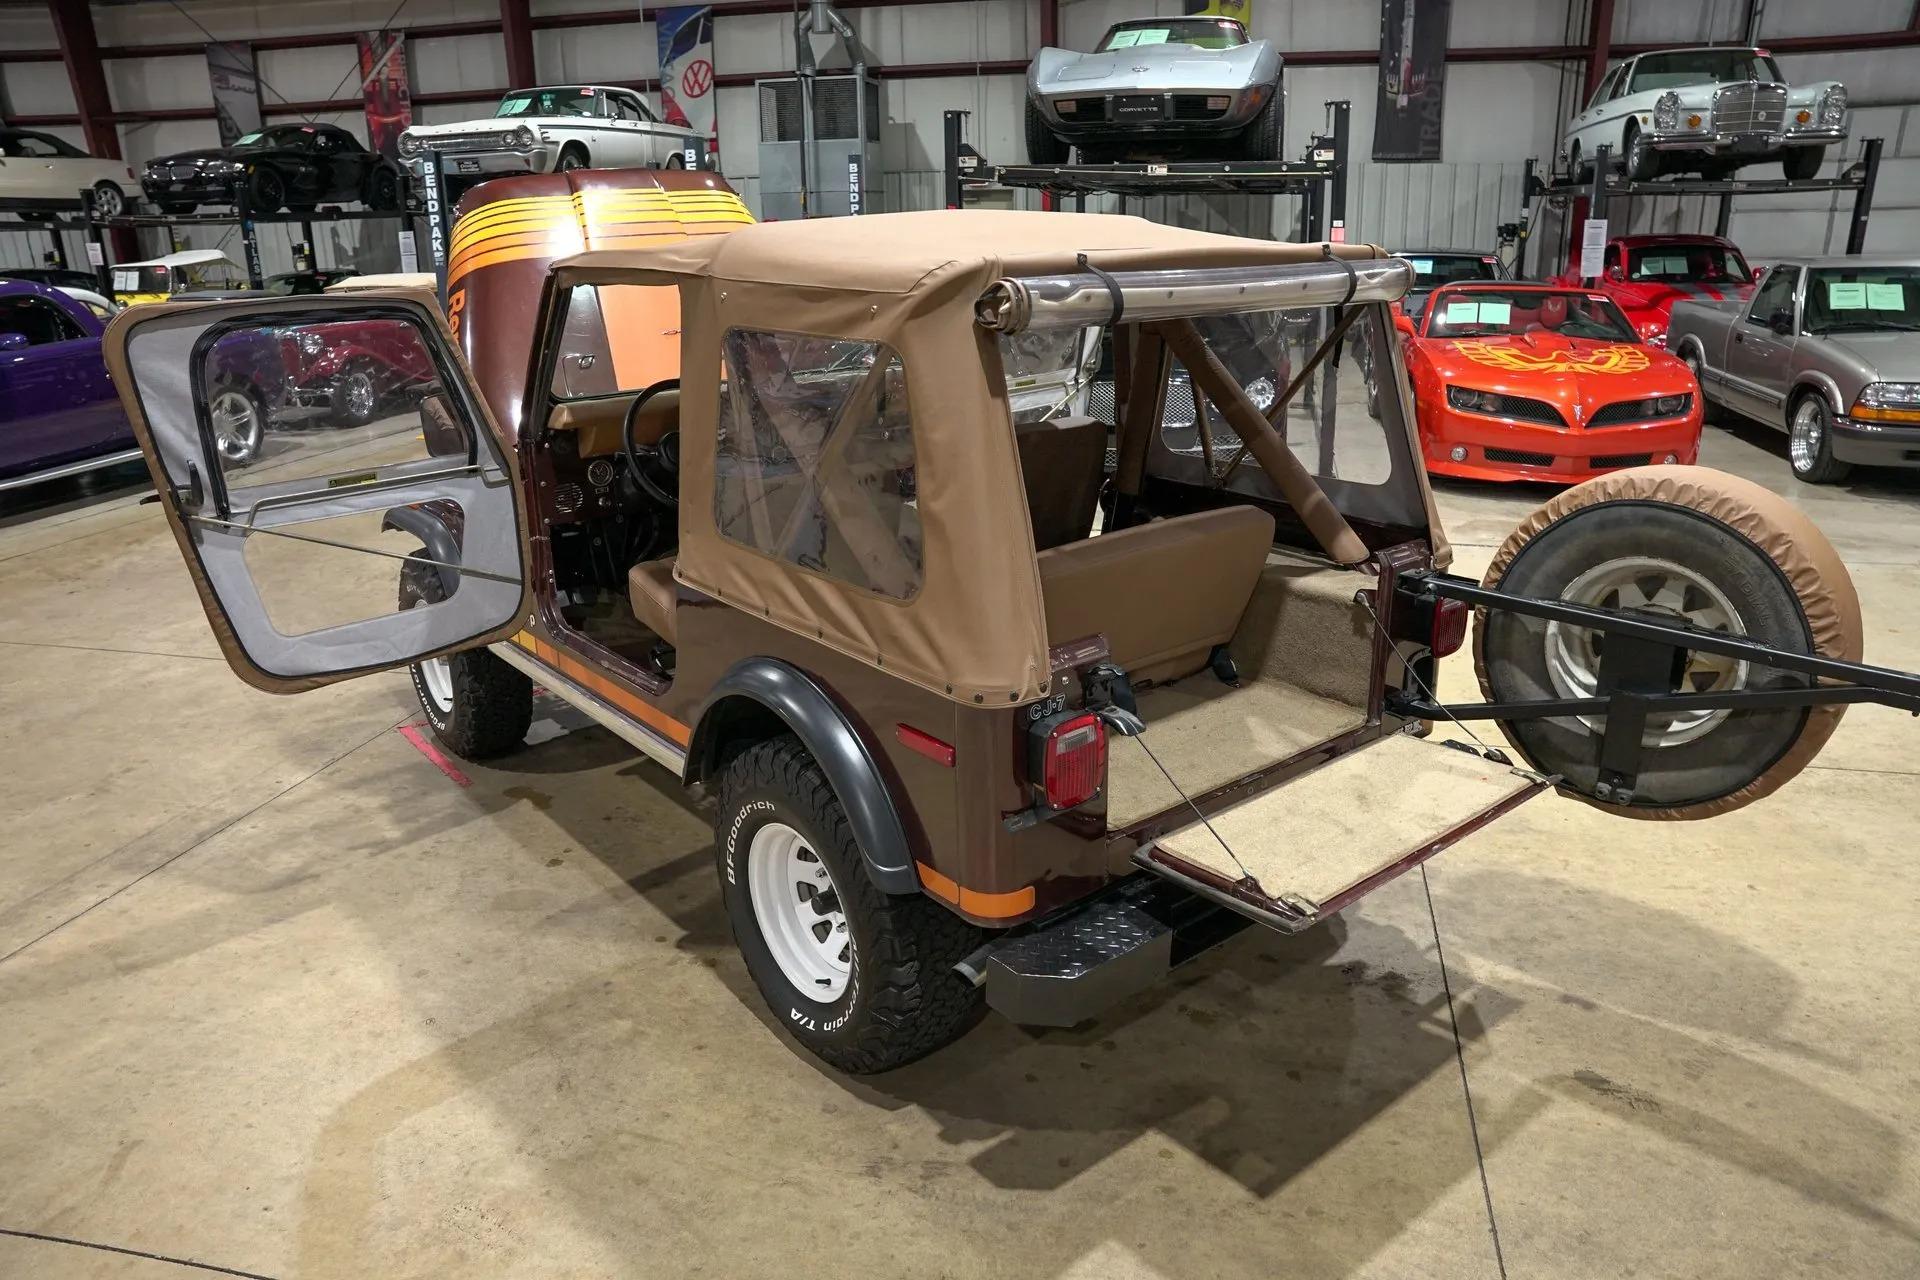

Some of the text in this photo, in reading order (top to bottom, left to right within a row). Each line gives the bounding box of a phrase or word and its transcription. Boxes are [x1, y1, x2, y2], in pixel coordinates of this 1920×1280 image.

[423, 161, 444, 251] BENDPAK
[849, 163, 860, 216] BENDP
[249, 231, 260, 273] ATLAS
[725, 800, 776, 886] BFGoodrich
[790, 1006, 816, 1031] T/A
